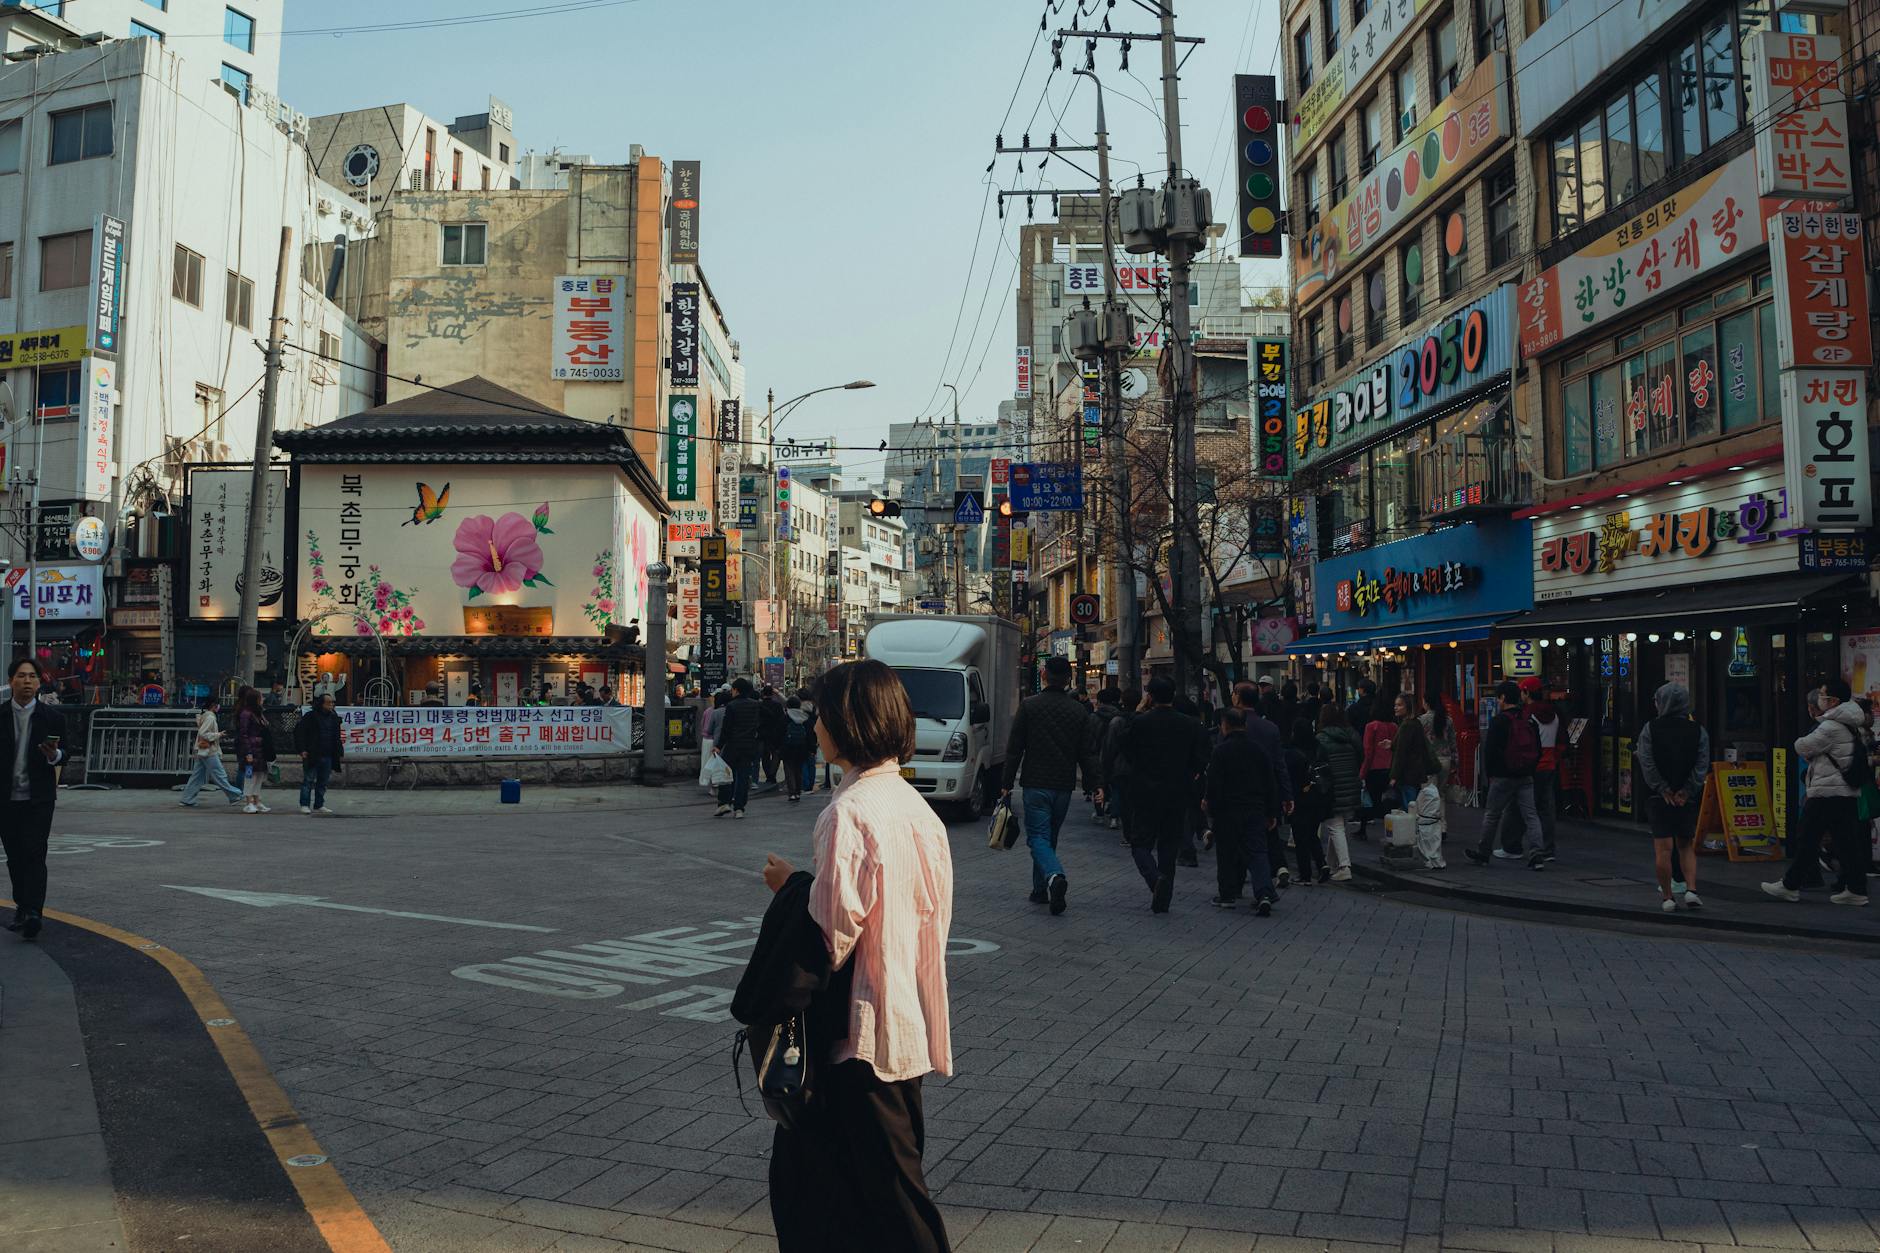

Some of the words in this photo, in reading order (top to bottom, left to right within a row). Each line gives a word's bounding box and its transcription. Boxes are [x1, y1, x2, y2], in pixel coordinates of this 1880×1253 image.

[1468, 101, 1491, 147] 3층
[1775, 113, 1844, 148] 쥬스
[1778, 154, 1847, 190] 박스
[1616, 210, 1661, 246] 전통의
[1662, 199, 1677, 220] 맛
[1785, 217, 1859, 237] 장수한방
[1069, 268, 1098, 289] 종로
[1114, 267, 1166, 289] 임랜드
[1575, 258, 1630, 322] 한방
[1637, 197, 1744, 293] 삼계탕
[562, 280, 589, 292] 종로
[596, 279, 613, 293] 탑
[1523, 277, 1550, 332] 장수
[1799, 245, 1856, 340] 삼계탕
[566, 297, 614, 365] 부동산
[676, 297, 696, 376] 한옥갈비
[570, 368, 621, 378] 745-0033
[1018, 357, 1029, 391] 게임랜드
[1262, 344, 1281, 380] 부킹
[1729, 343, 1747, 401] 전문
[1822, 348, 1844, 361] 2F
[1259, 383, 1286, 398] 라이브
[1295, 396, 1332, 458] 부킹
[1336, 365, 1392, 434] 라이브
[1400, 309, 1487, 409] 2050
[1628, 360, 1713, 431] 삼계탕
[1803, 378, 1858, 406] 치킨
[1264, 400, 1285, 471] 2050
[676, 424, 688, 495] 태성골뱅이
[1812, 411, 1860, 523] 호프
[671, 510, 707, 521] 사랑방
[1641, 507, 1711, 557] 치킨
[198, 511, 214, 593] 북촌무궁화
[339, 474, 363, 606] 북촌무궁화
[1818, 539, 1864, 556] 부동산
[707, 570, 720, 589] 5
[1354, 569, 1381, 617] 을지로
[1382, 566, 1412, 613] 골뱅이
[1421, 564, 1442, 593] 치킨
[1444, 560, 1464, 592] 호프
[683, 588, 700, 635] 부동산
[1076, 602, 1093, 616] 30
[704, 614, 715, 660] 종로3가
[344, 711, 366, 724] 4월
[373, 710, 419, 725] 4일(금)
[427, 710, 468, 724] 대통령
[476, 709, 544, 723] 헌법재판소
[551, 709, 574, 722] 선고
[581, 708, 603, 722] 당일
[464, 727, 490, 743] 5번
[499, 726, 531, 743] 출구
[539, 725, 613, 743] 폐쇄합니다
